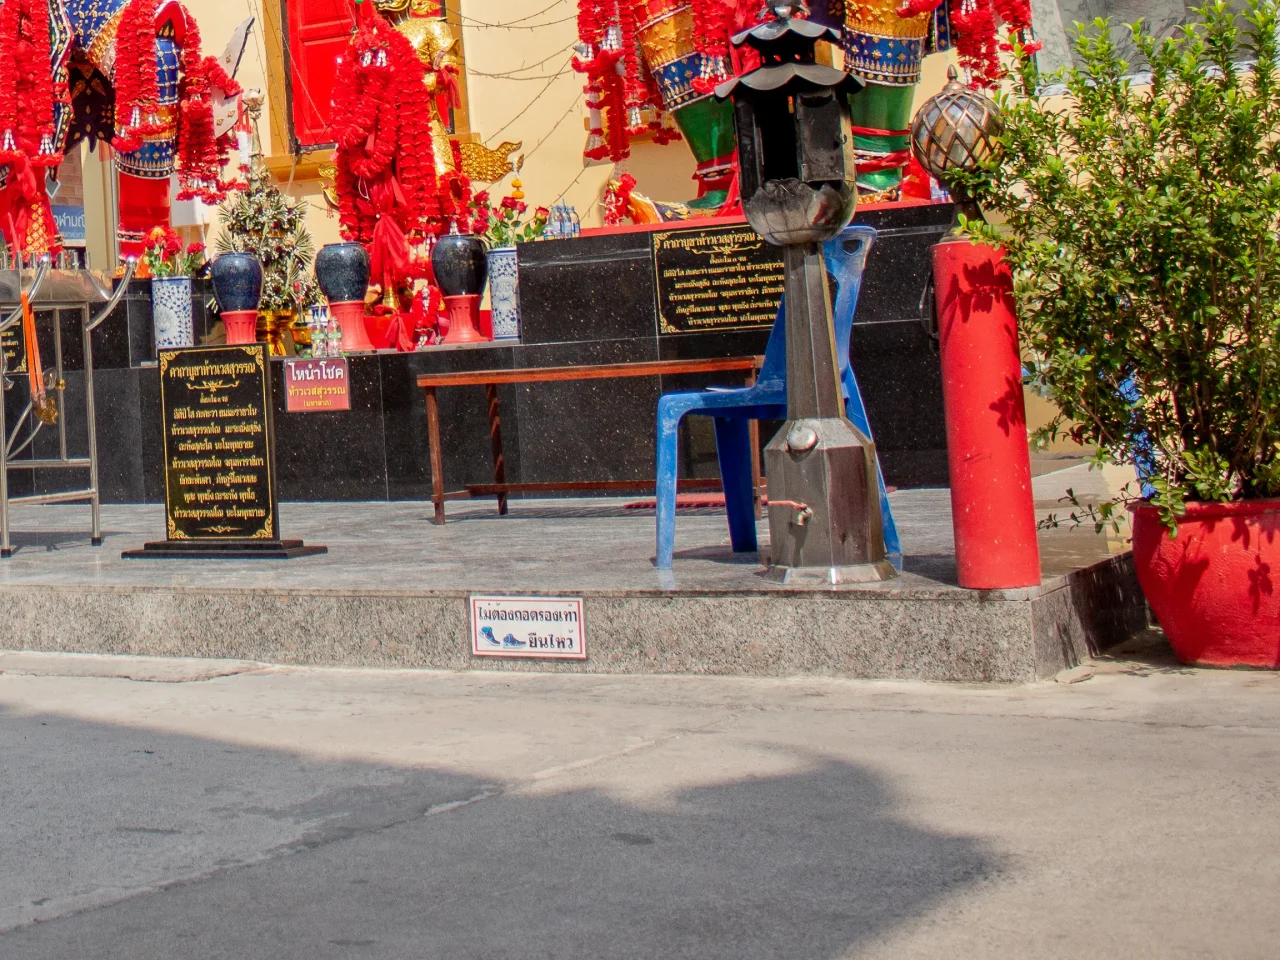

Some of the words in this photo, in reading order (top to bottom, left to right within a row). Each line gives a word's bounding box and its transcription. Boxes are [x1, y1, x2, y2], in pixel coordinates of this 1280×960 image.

[170, 360, 256, 381] คาถาบูชาท้าวเวสสุวรรณ
[288, 360, 344, 381] ไหนำโชค
[288, 385, 346, 400] ท้าวเวสสุวรรณ
[477, 602, 578, 622] ไม่ต้องถอดรองเท้า
[528, 628, 573, 649] ยืนไหว้
